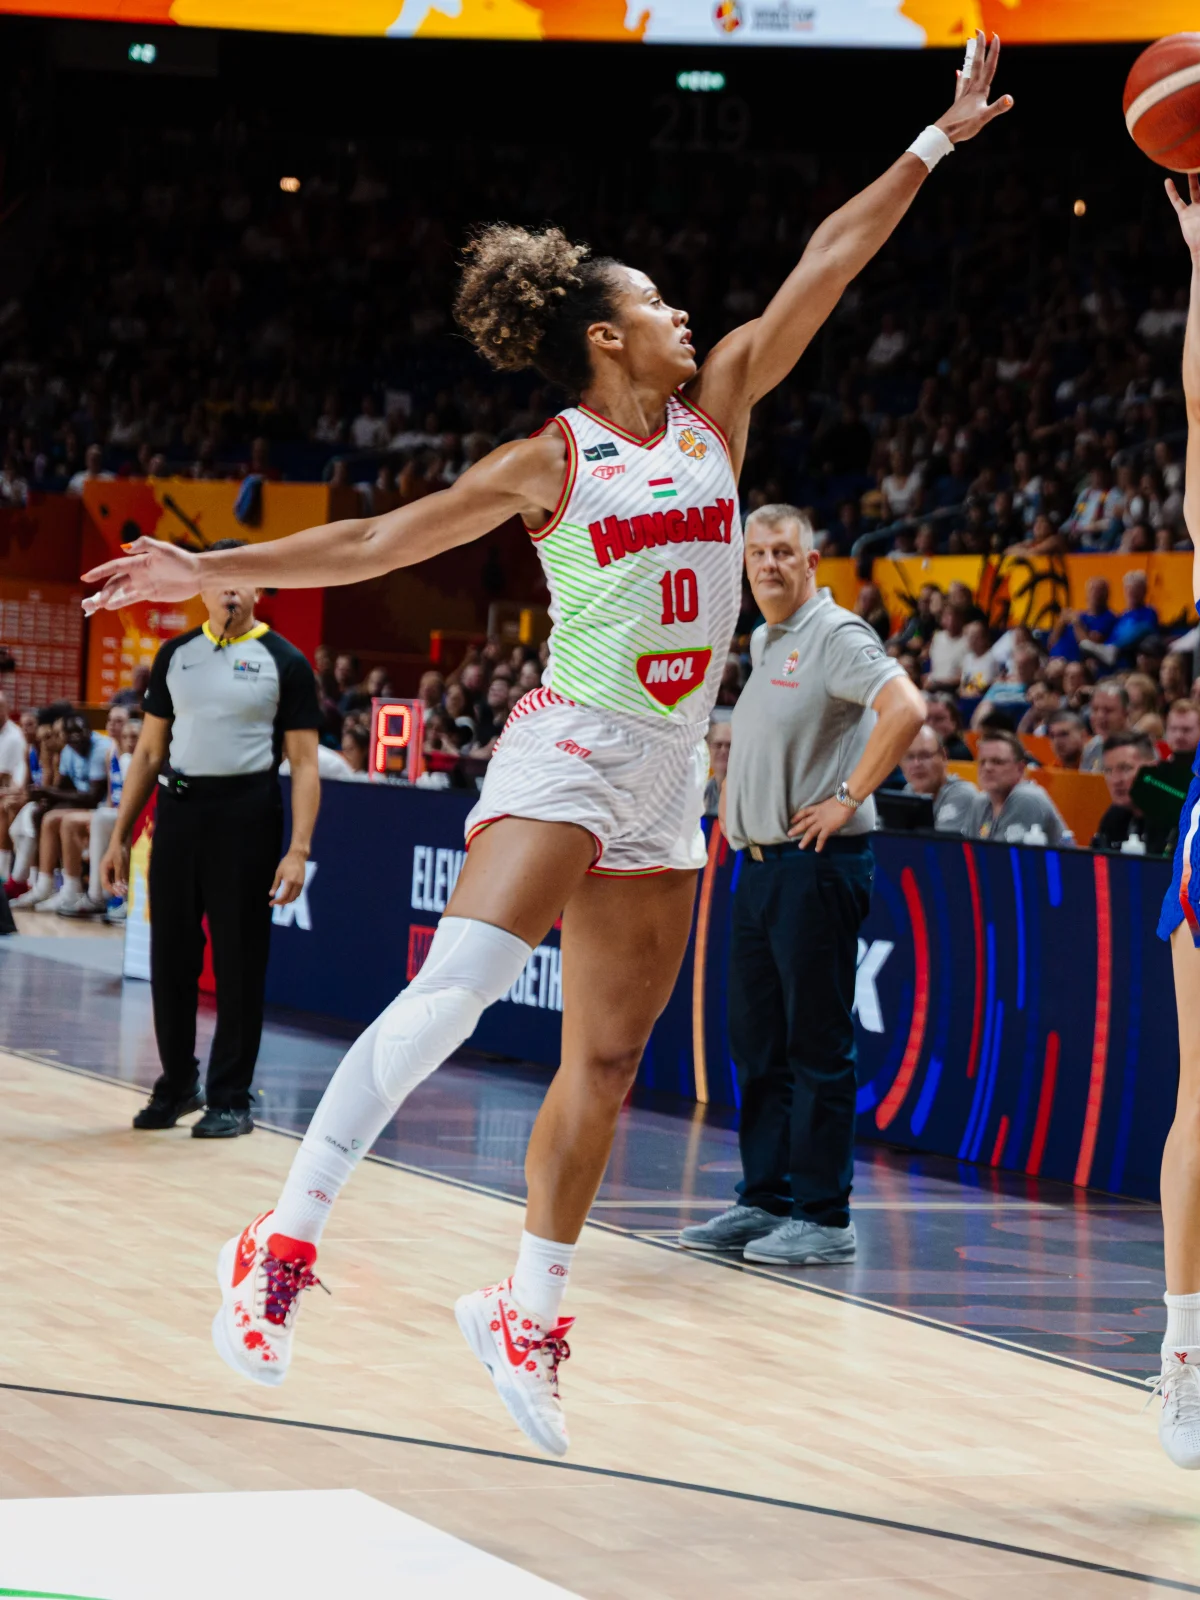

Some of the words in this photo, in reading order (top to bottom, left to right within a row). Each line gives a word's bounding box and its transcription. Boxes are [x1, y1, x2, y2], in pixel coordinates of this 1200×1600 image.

[588, 498, 735, 568] HUNGARY
[659, 568, 699, 626] 10
[645, 656, 695, 684] MOL
